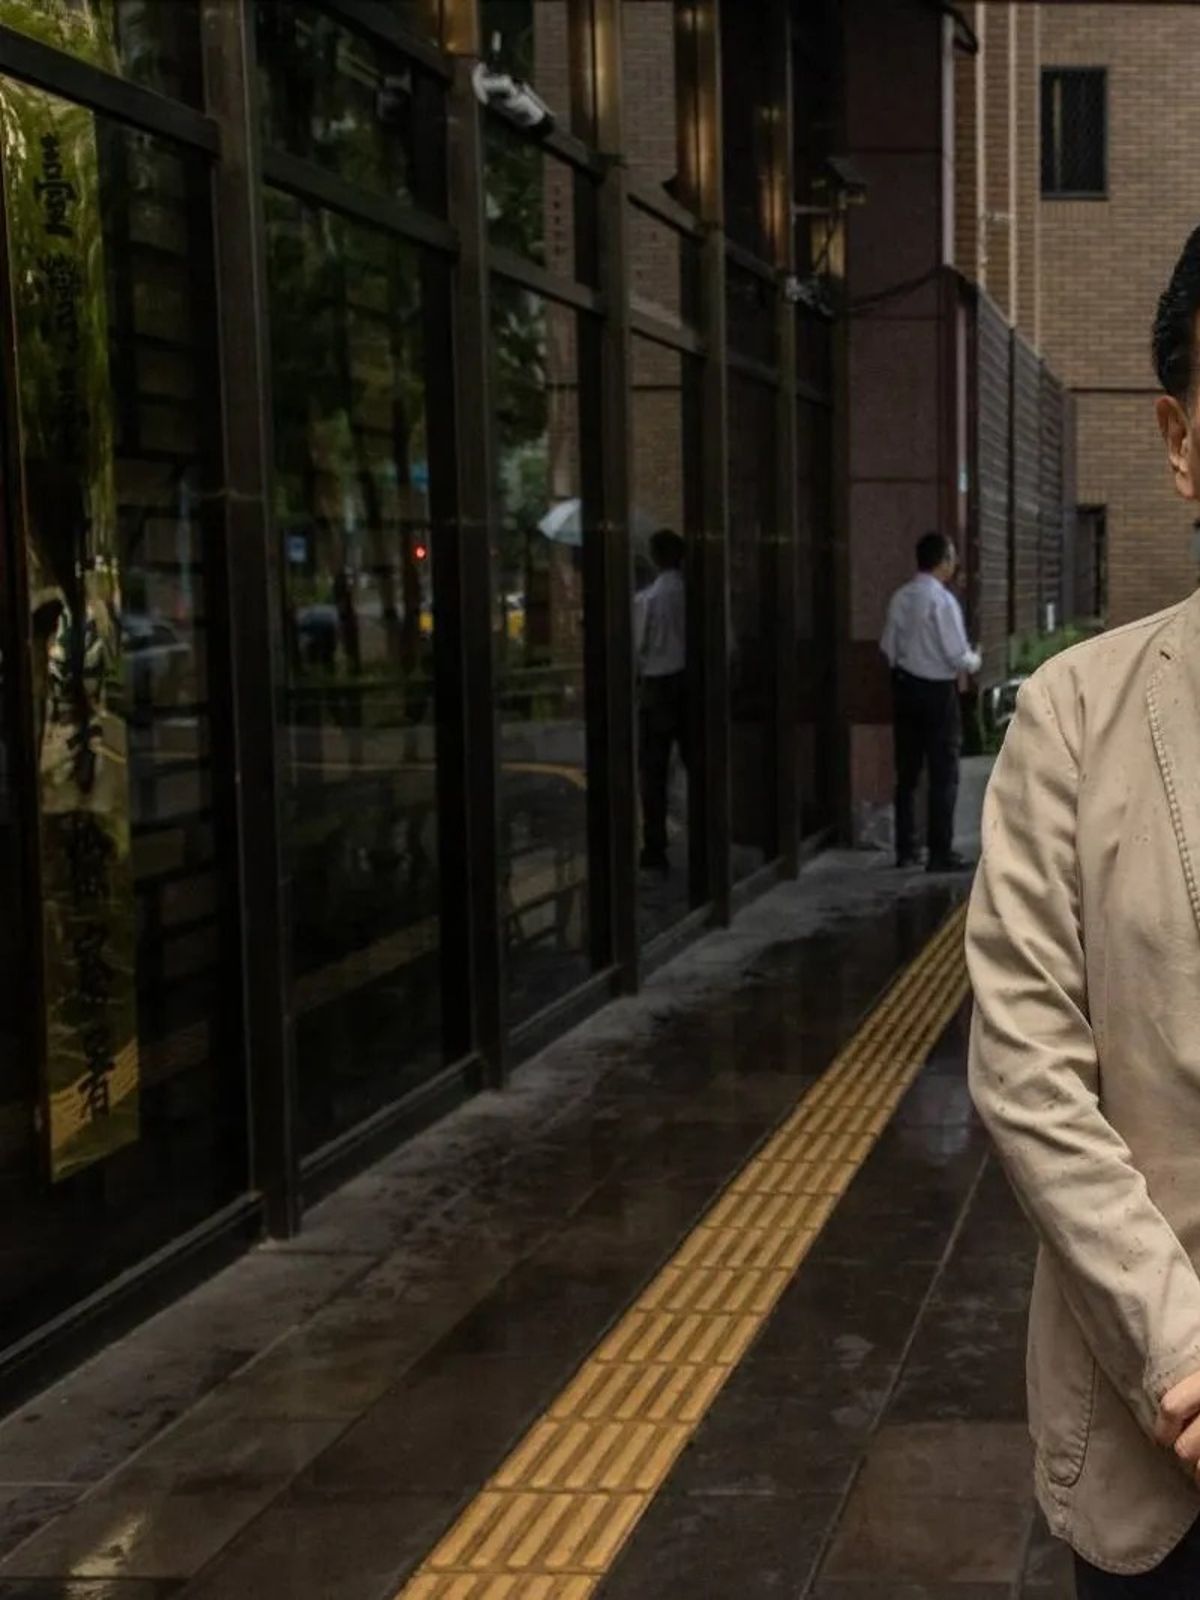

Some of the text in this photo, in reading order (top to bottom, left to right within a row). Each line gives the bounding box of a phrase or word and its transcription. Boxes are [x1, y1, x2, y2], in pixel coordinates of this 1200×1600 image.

[33, 132, 115, 1119] 臺灣臺方檢察署
